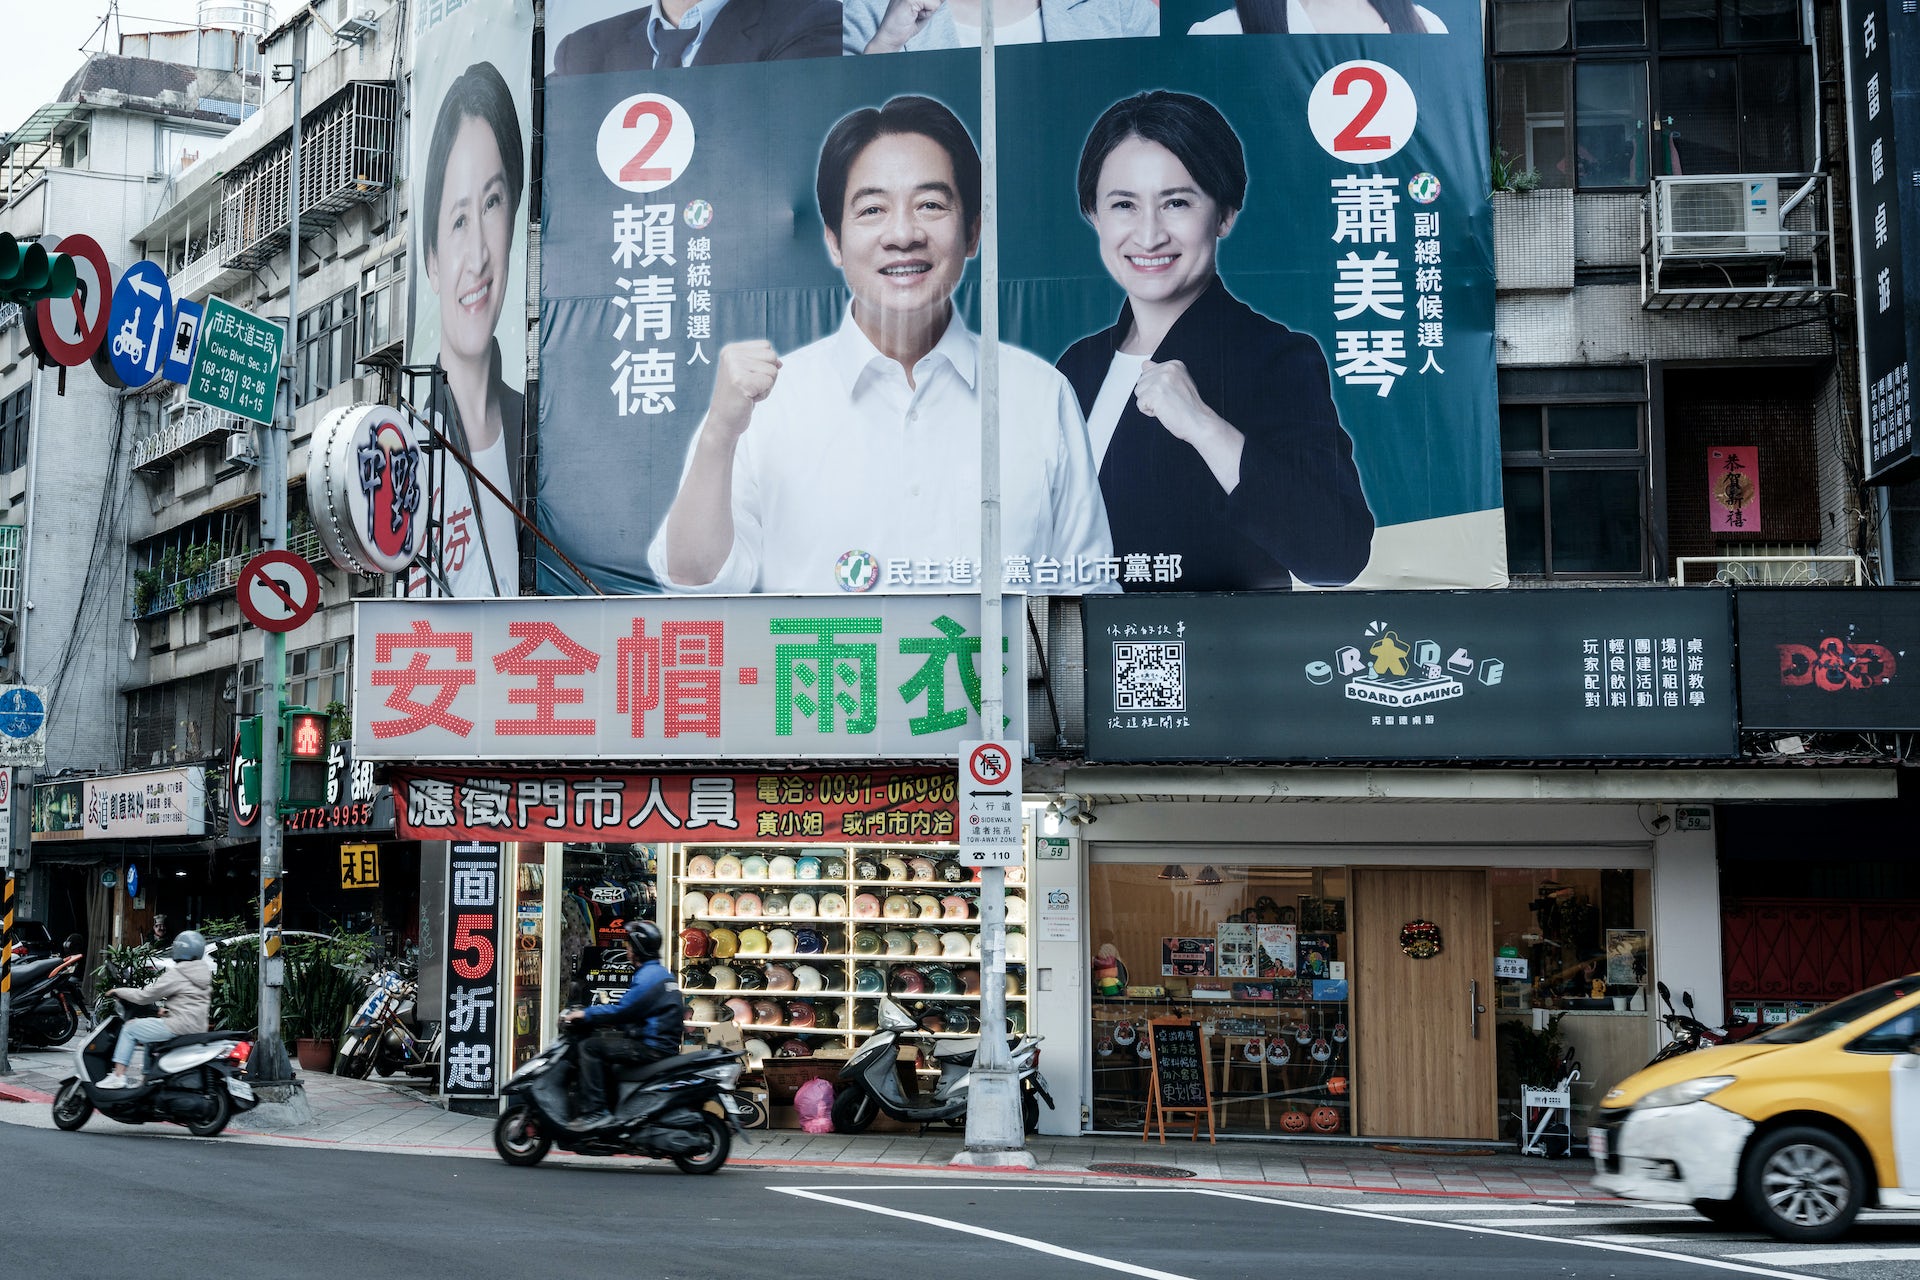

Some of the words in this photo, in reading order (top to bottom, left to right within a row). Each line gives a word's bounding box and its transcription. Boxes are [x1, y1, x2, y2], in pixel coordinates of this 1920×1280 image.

[1332, 67, 1391, 152] 2
[619, 101, 673, 182] 2
[686, 236, 711, 366] 總統候選人
[1331, 174, 1408, 398] 蕭美琴
[1413, 211, 1445, 375] 副總統候選人
[610, 203, 677, 416] 賴清德
[212, 310, 275, 355] 市民大道三段
[201, 359, 235, 384] 168-126
[210, 341, 229, 359] Civic
[229, 350, 246, 366] Blvd.
[247, 356, 261, 372] Sec.
[262, 362, 268, 374] 3
[241, 374, 266, 396] 92-86
[239, 392, 264, 413] 41-15
[886, 553, 1184, 586] 民主進黨台北市黨部
[1107, 620, 1186, 638] 你我的故事
[1583, 638, 1601, 708] 玩家配對
[1608, 638, 1627, 708] 輕食飲料
[1634, 638, 1653, 708] 團建活動
[1660, 638, 1679, 708] 場地租借
[1687, 637, 1706, 707] 桌游教學
[1347, 686, 1399, 705] BOARD
[1402, 685, 1462, 705] GAMING
[1371, 714, 1435, 726] 克雷德桌游
[980, 754, 1002, 776] 停
[408, 775, 740, 830] 應徵門市人員
[969, 801, 1011, 811] 人行道
[757, 810, 824, 836] 黃小姐
[842, 810, 954, 836] 或門市內洽
[972, 826, 1011, 835] 違者拖吊
[1687, 817, 1701, 827] 59
[343, 850, 379, 885] 租
[992, 852, 1010, 860] 110
[1050, 847, 1063, 857] 59
[586, 974, 635, 983] 特約經銷
